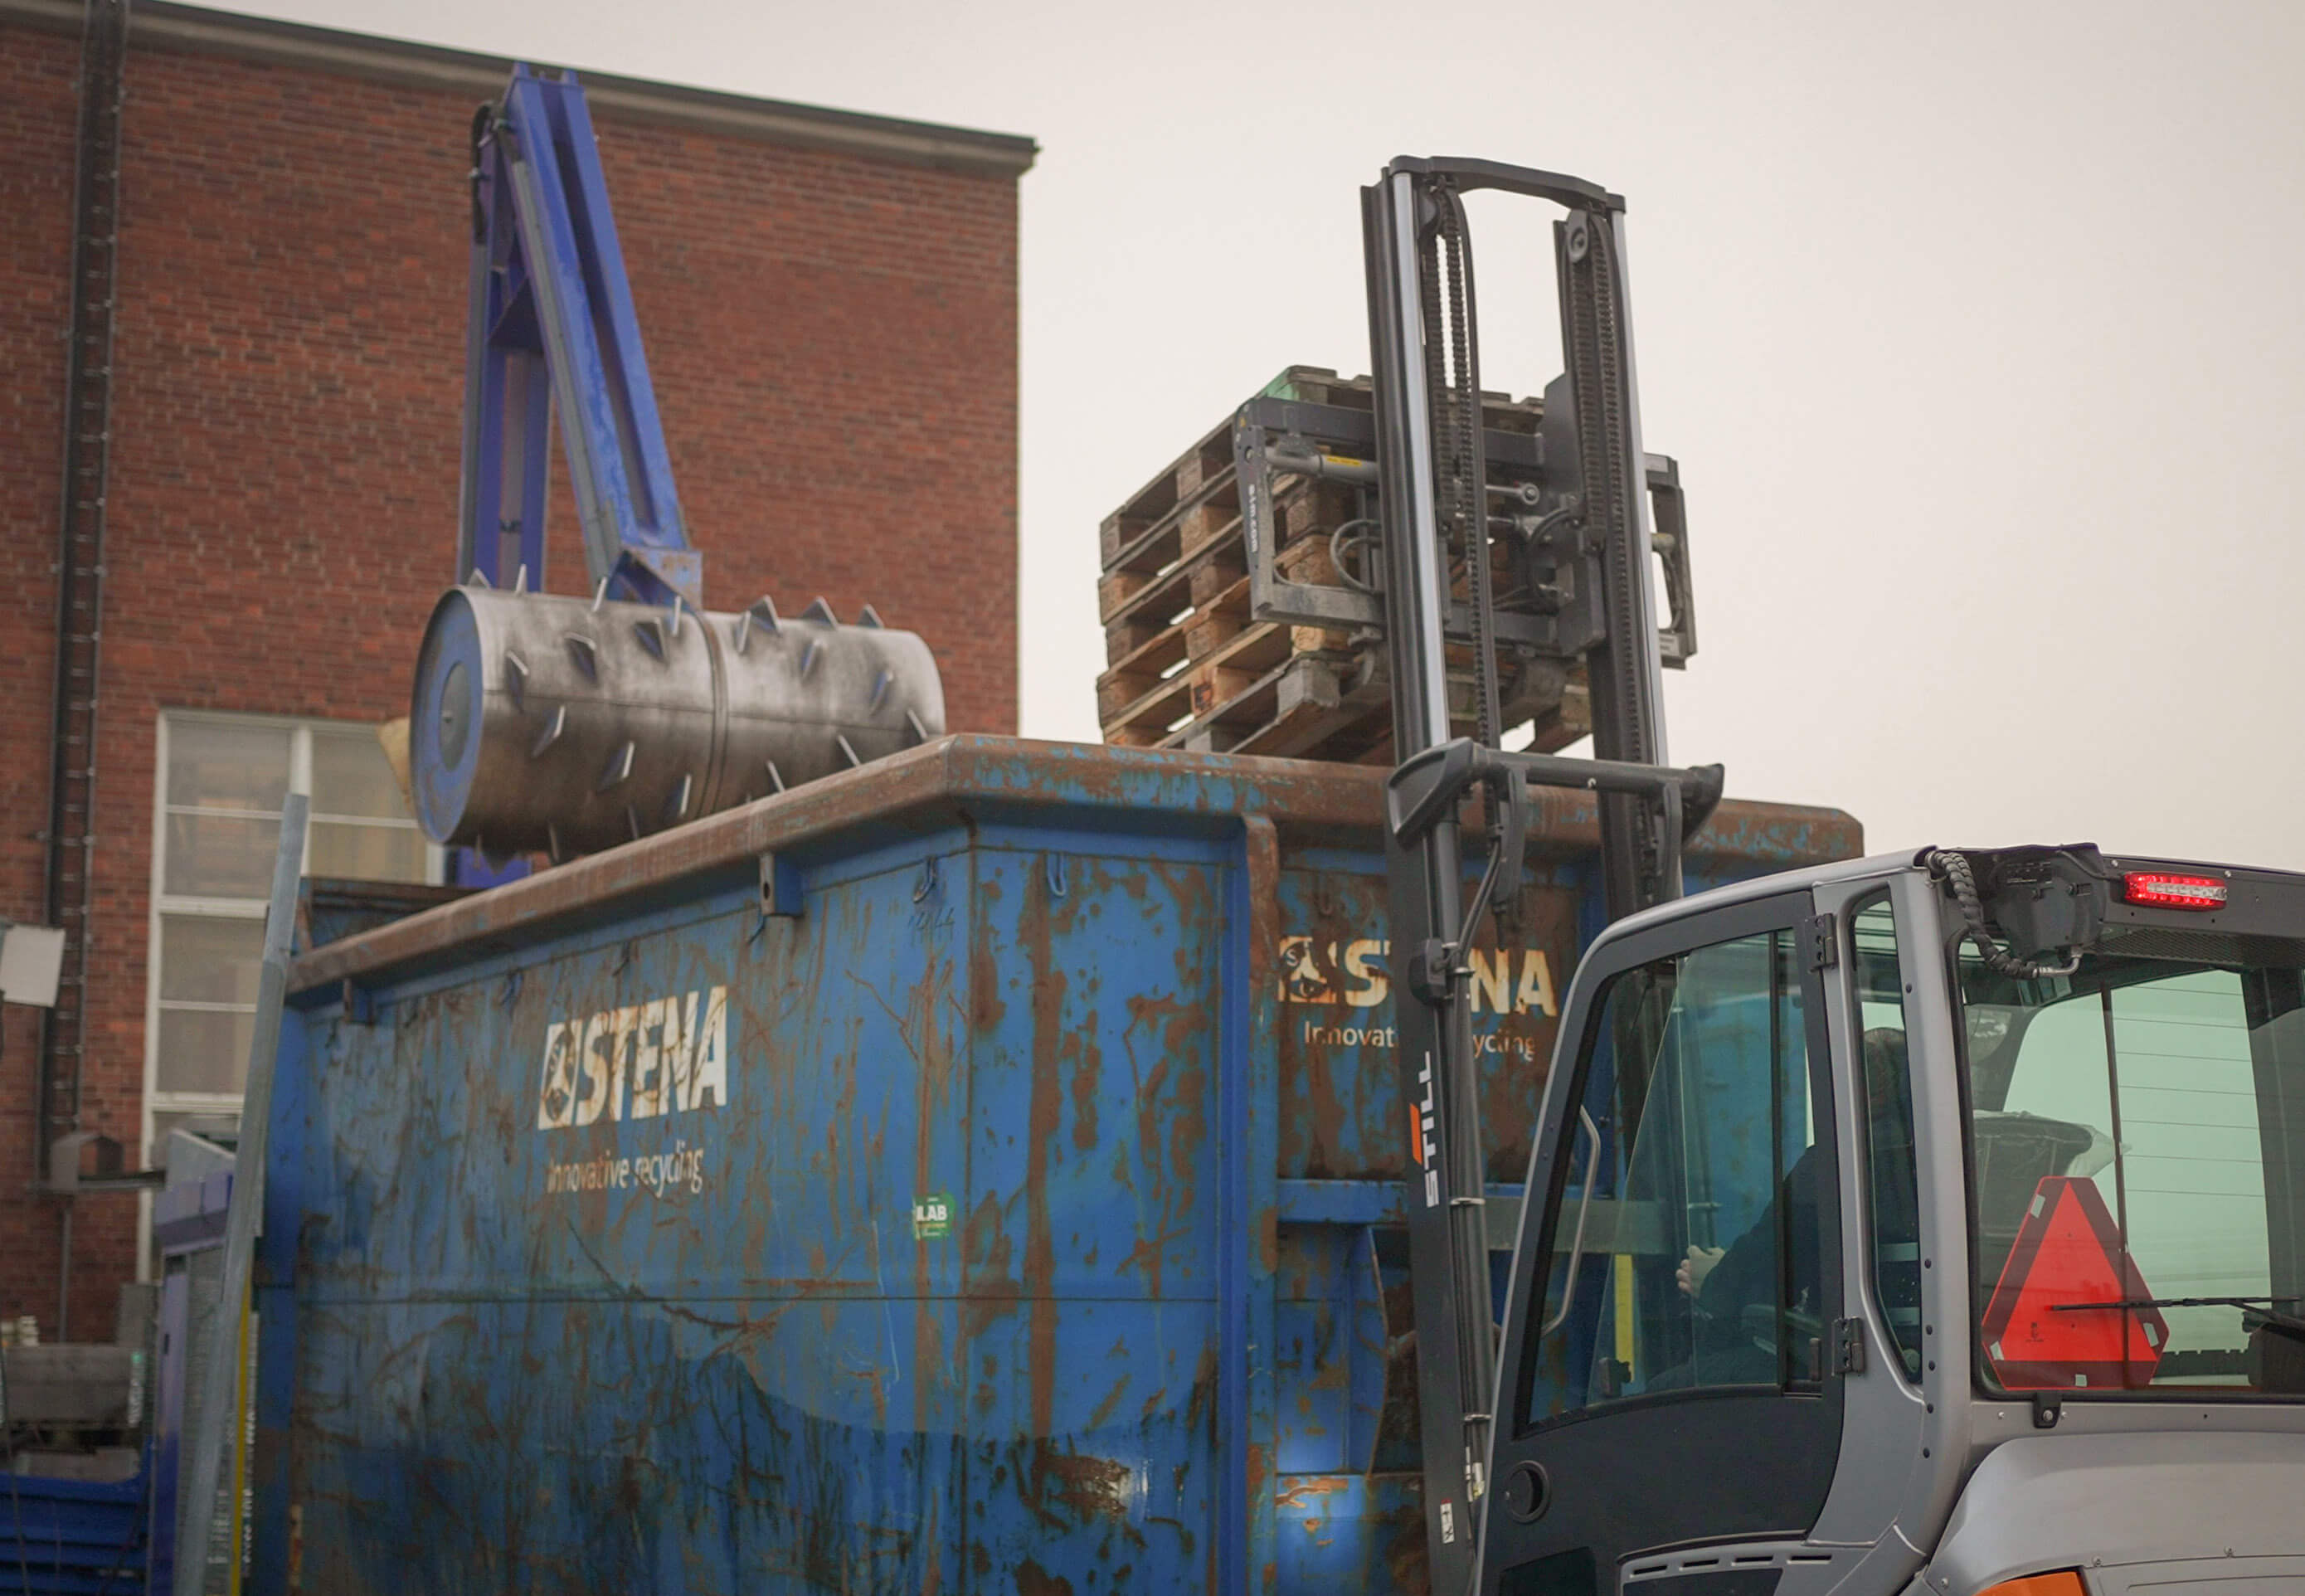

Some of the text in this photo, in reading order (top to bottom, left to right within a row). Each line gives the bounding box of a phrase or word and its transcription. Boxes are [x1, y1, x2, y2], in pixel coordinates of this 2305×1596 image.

[1345, 939, 1558, 1017] SNA
[576, 985, 727, 1126] STENA
[1305, 1020, 1398, 1048] Innovat
[1418, 1050, 1440, 1208] STILL
[635, 1139, 704, 1199] recycling
